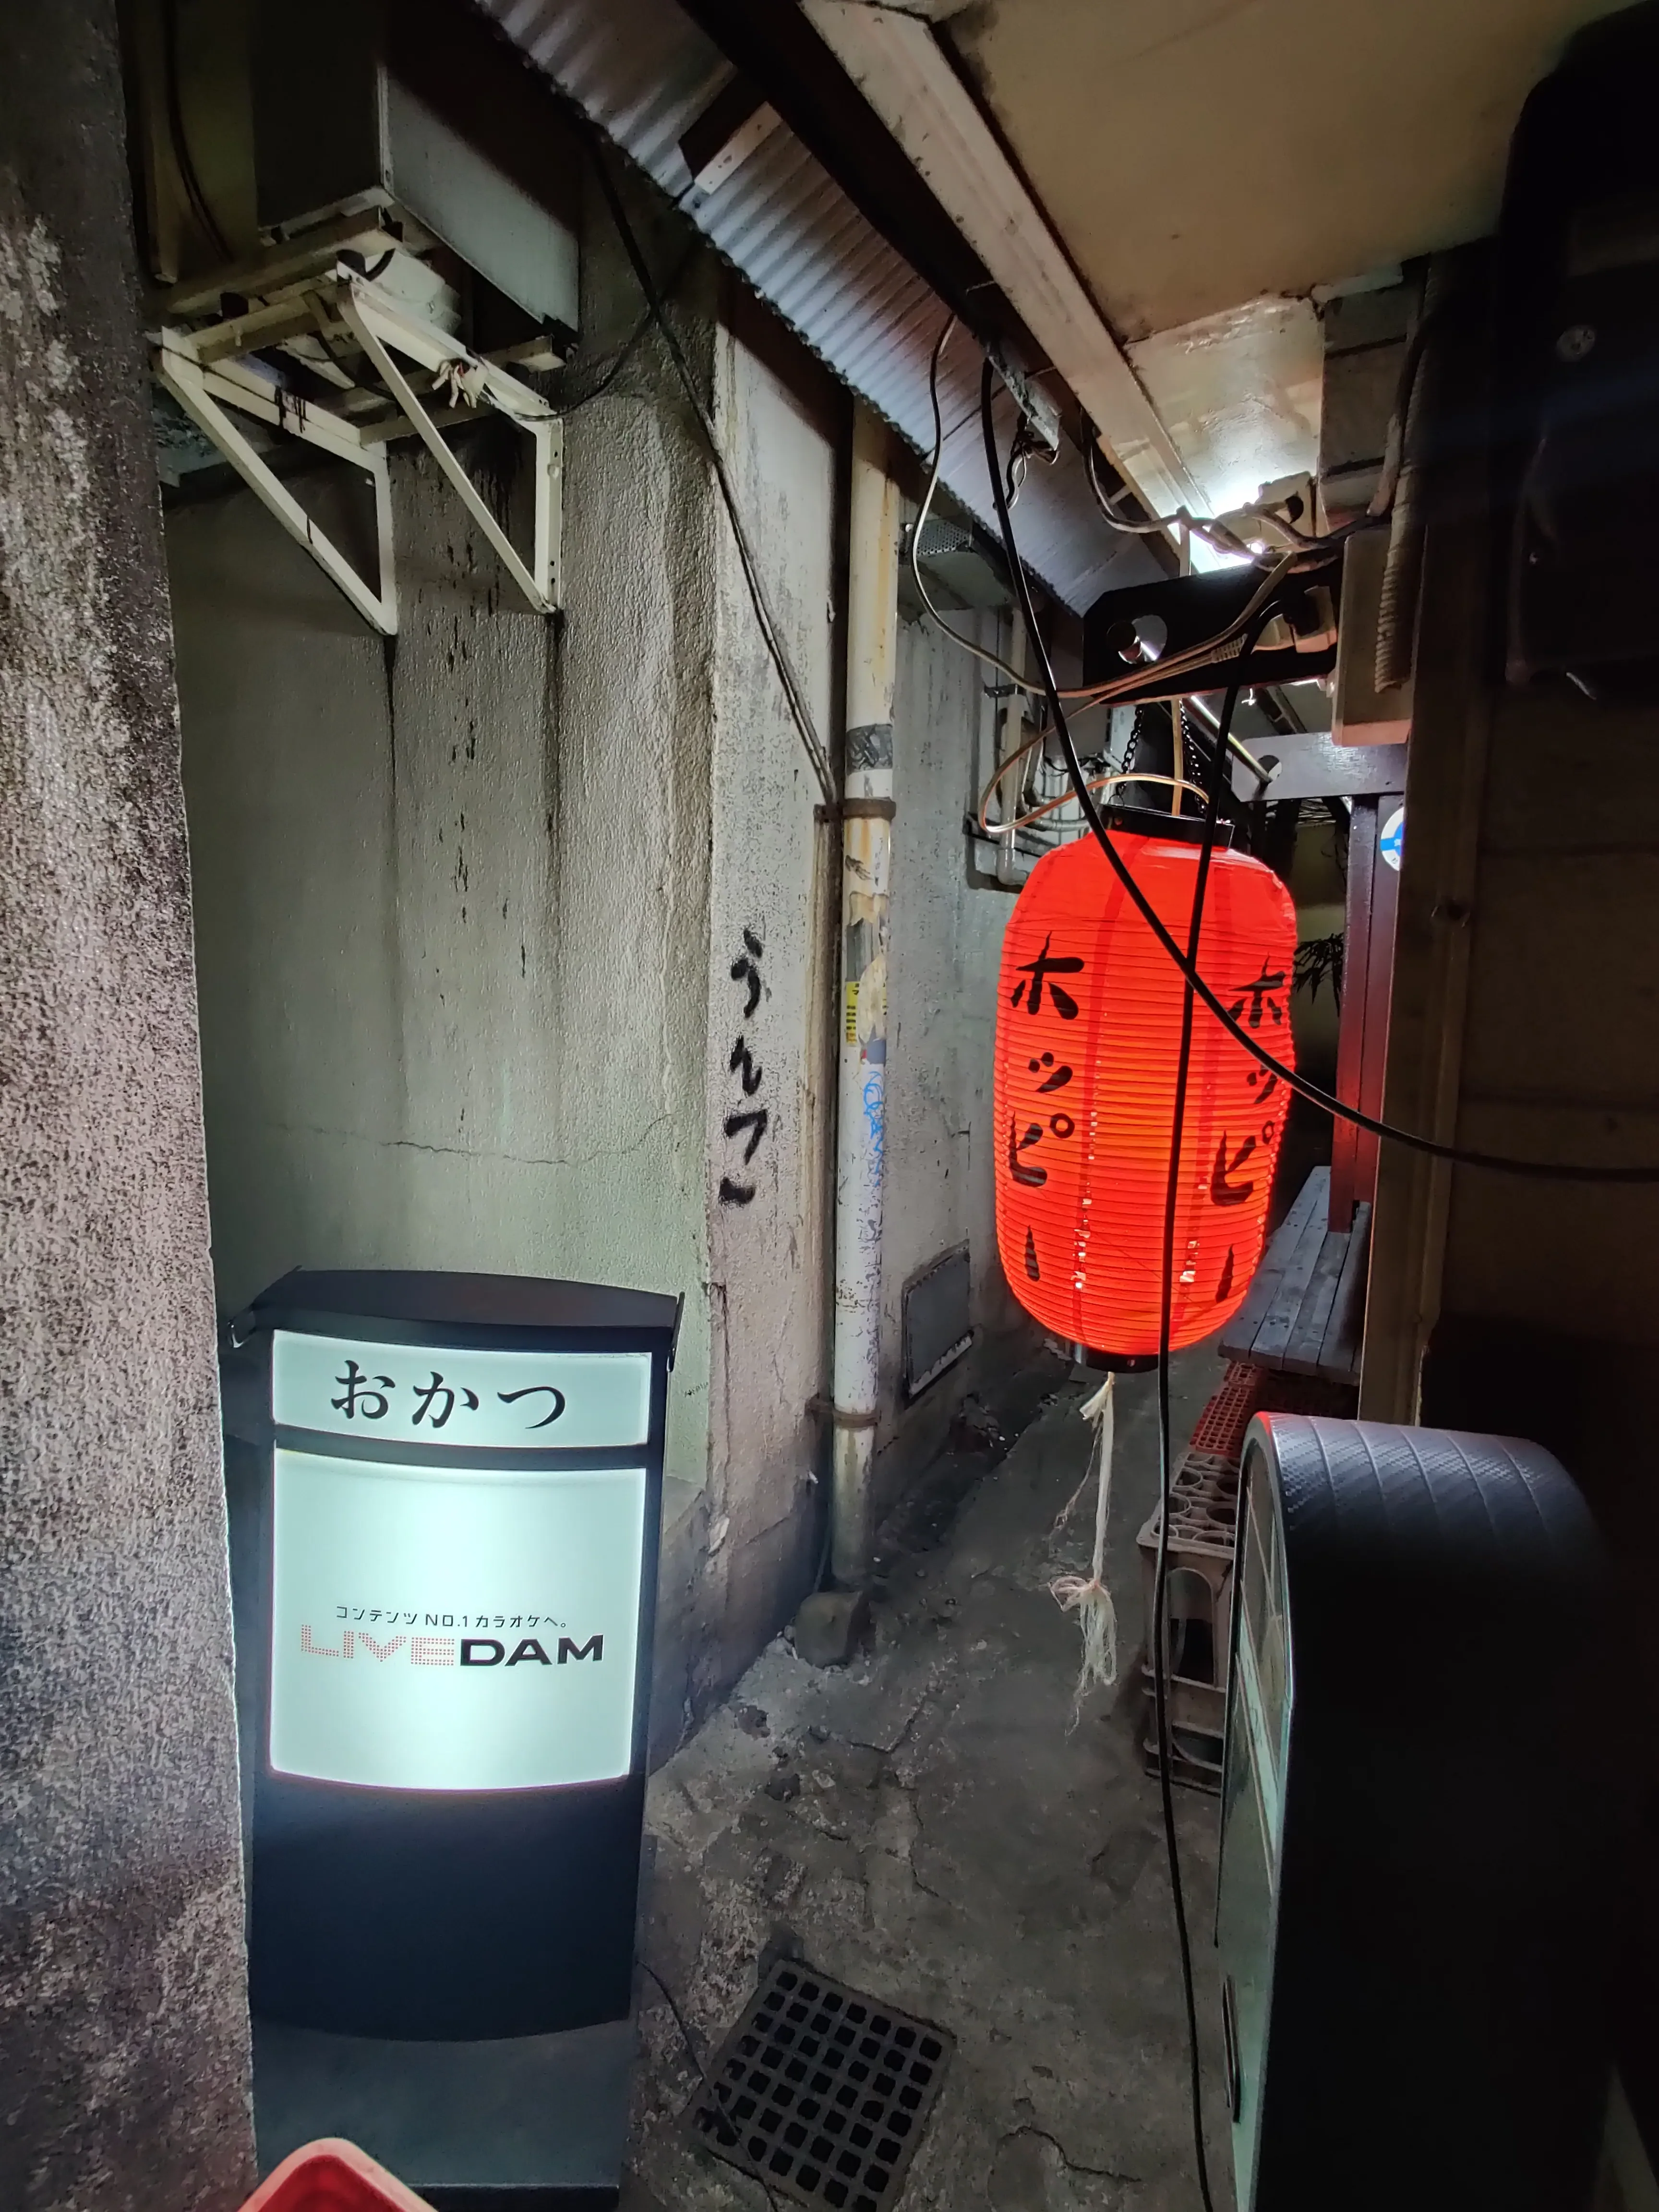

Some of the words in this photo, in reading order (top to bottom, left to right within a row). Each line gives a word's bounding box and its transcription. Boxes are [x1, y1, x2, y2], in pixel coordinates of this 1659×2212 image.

[1010, 931, 1085, 1282] ホッピー
[331, 1359, 566, 1430] おかつ
